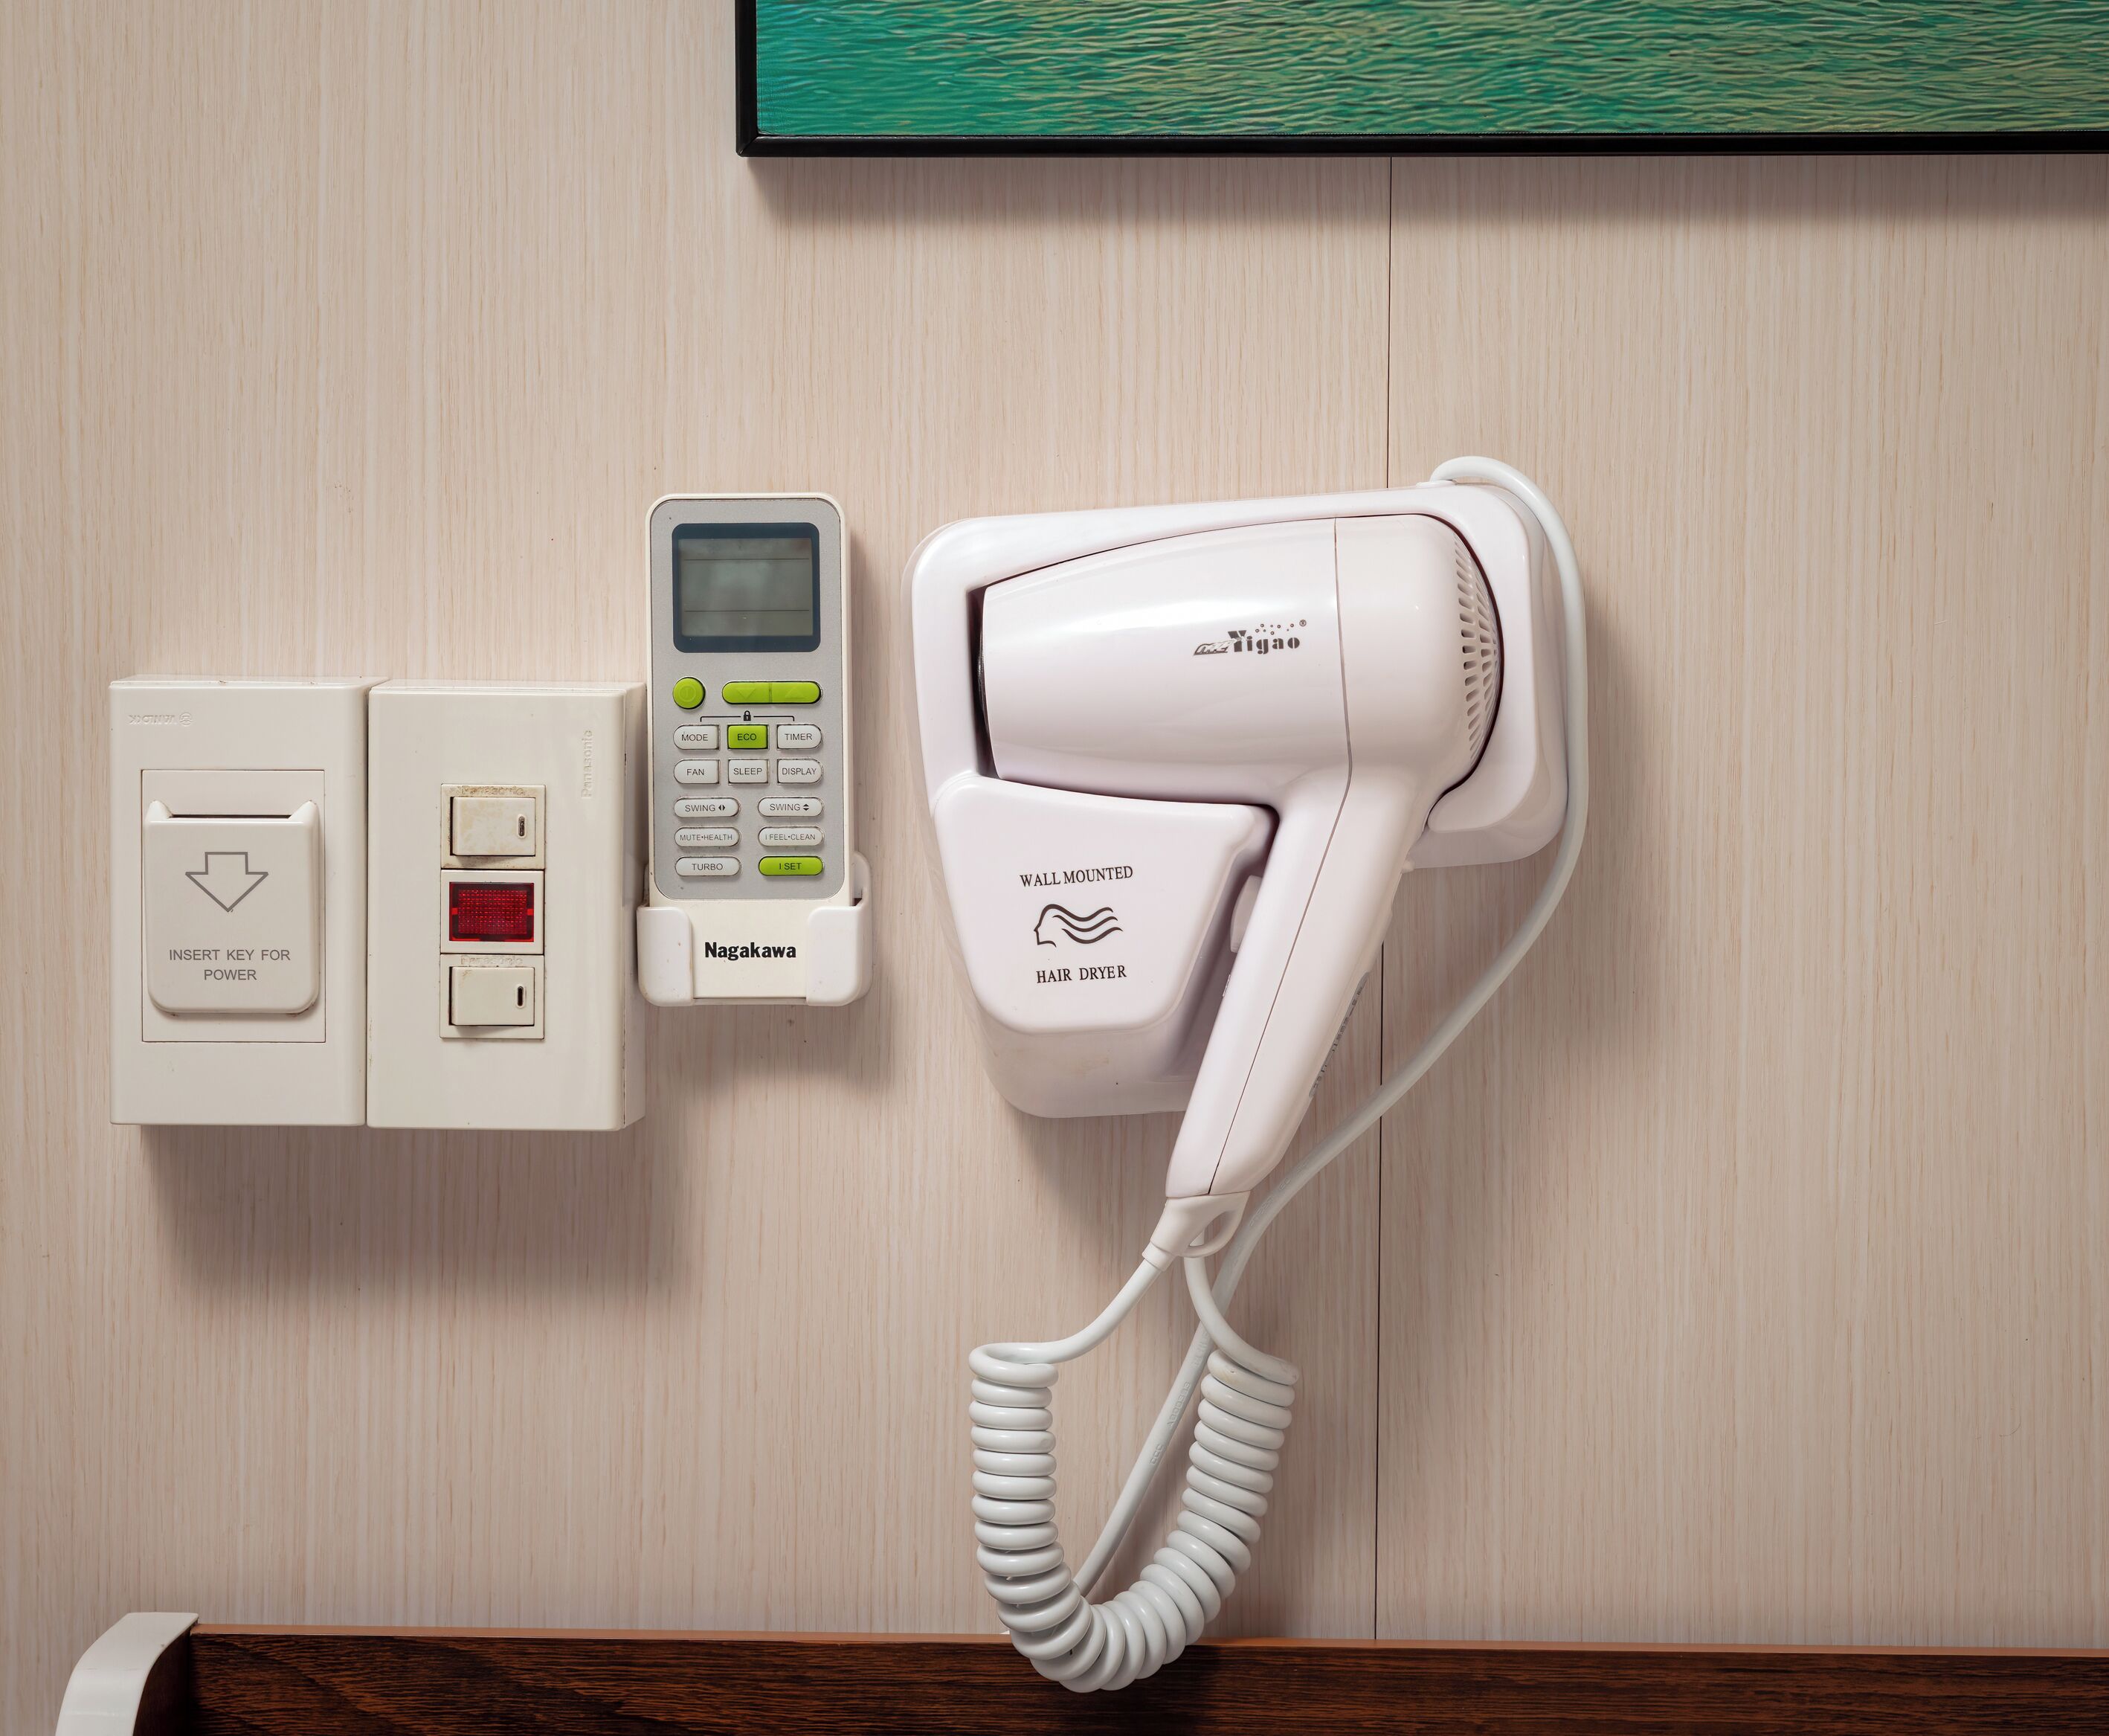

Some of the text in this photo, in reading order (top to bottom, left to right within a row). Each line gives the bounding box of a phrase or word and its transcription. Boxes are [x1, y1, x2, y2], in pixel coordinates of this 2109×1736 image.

[1226, 629, 1301, 656] Yigao
[681, 733, 709, 742] MODE
[737, 733, 757, 742] ECO
[785, 733, 813, 741] TIMER
[733, 768, 763, 776] SLEEP
[781, 767, 817, 776] DISPLAY
[685, 804, 716, 812] SWING
[769, 803, 801, 811] SWING
[692, 863, 724, 871] TURBO
[784, 862, 802, 871] SET
[1019, 865, 1133, 887] WALL MOUNTED
[169, 949, 291, 961] INSERT KEY FOR
[704, 942, 796, 962] Nagakawa
[204, 968, 257, 981] POWER
[1035, 965, 1127, 984] HAIR DRYER
